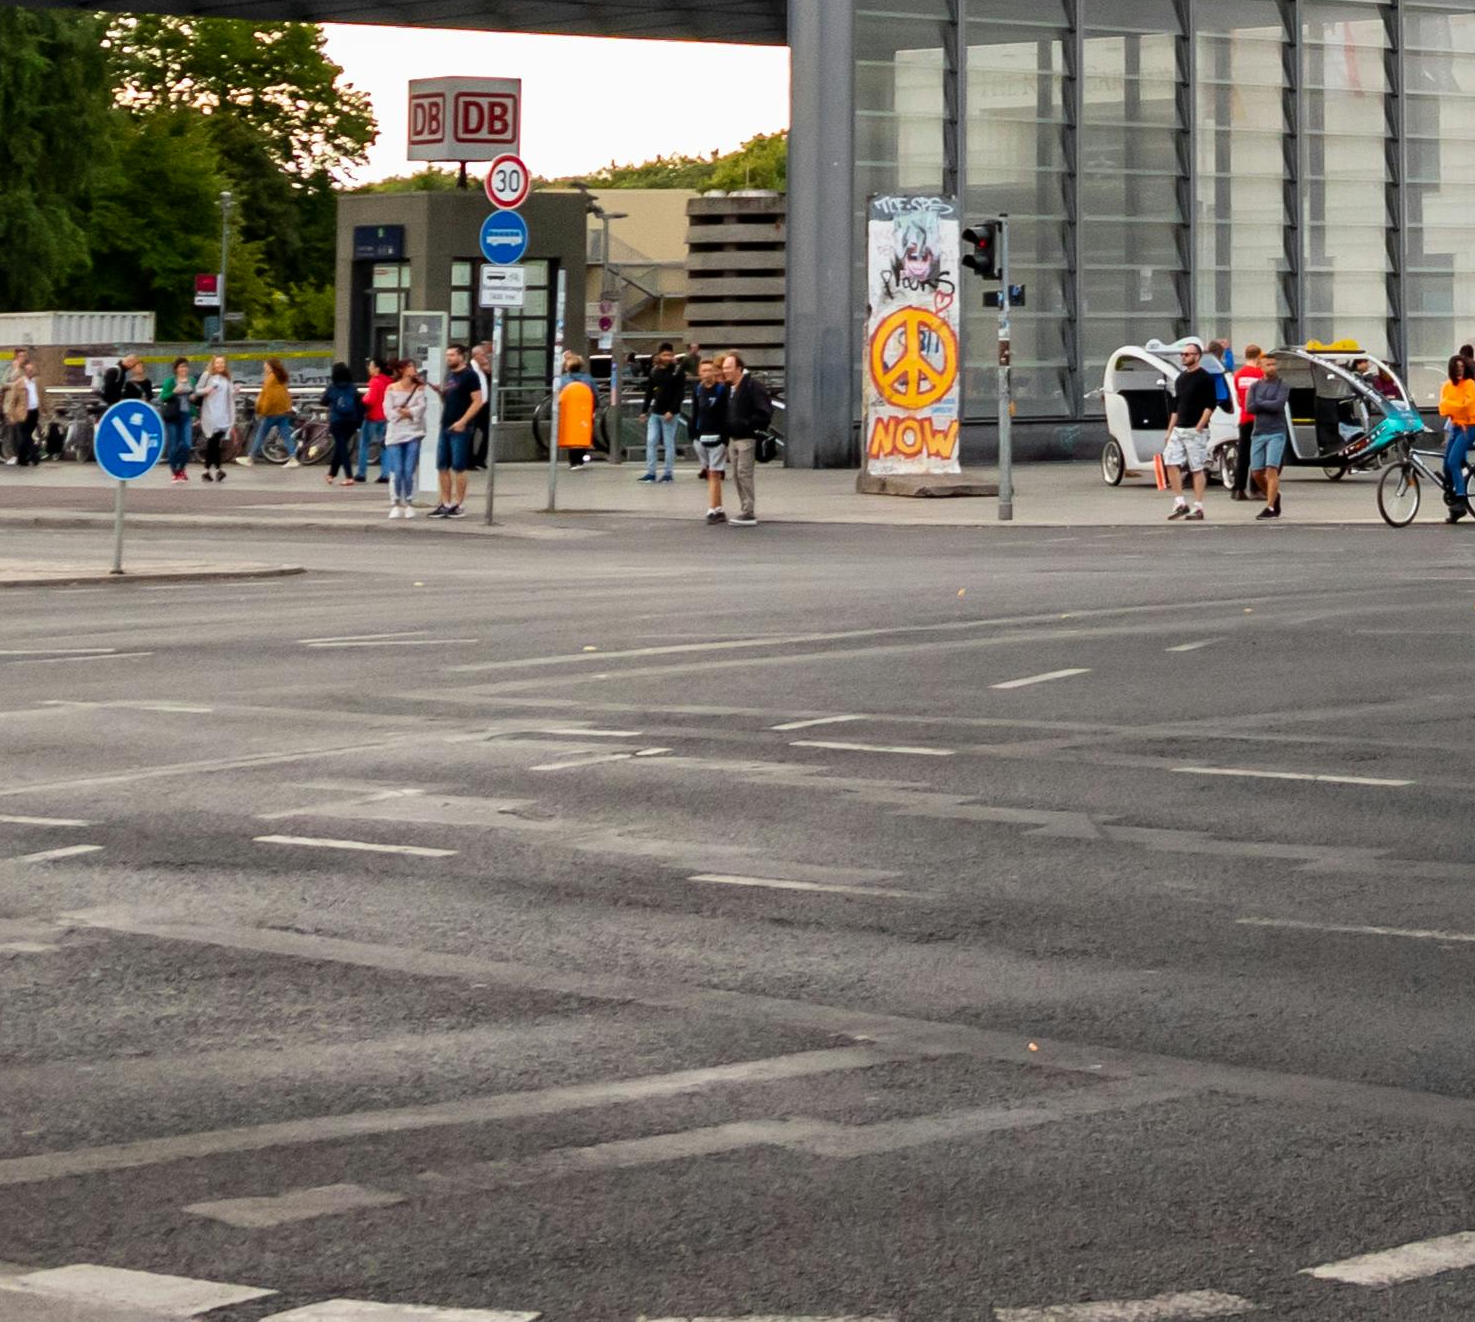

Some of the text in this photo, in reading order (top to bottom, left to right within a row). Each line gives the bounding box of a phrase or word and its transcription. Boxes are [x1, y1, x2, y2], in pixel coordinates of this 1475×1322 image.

[412, 101, 441, 136] DB
[462, 101, 509, 135] DB
[495, 169, 520, 193] 30
[868, 415, 959, 460] NOW
